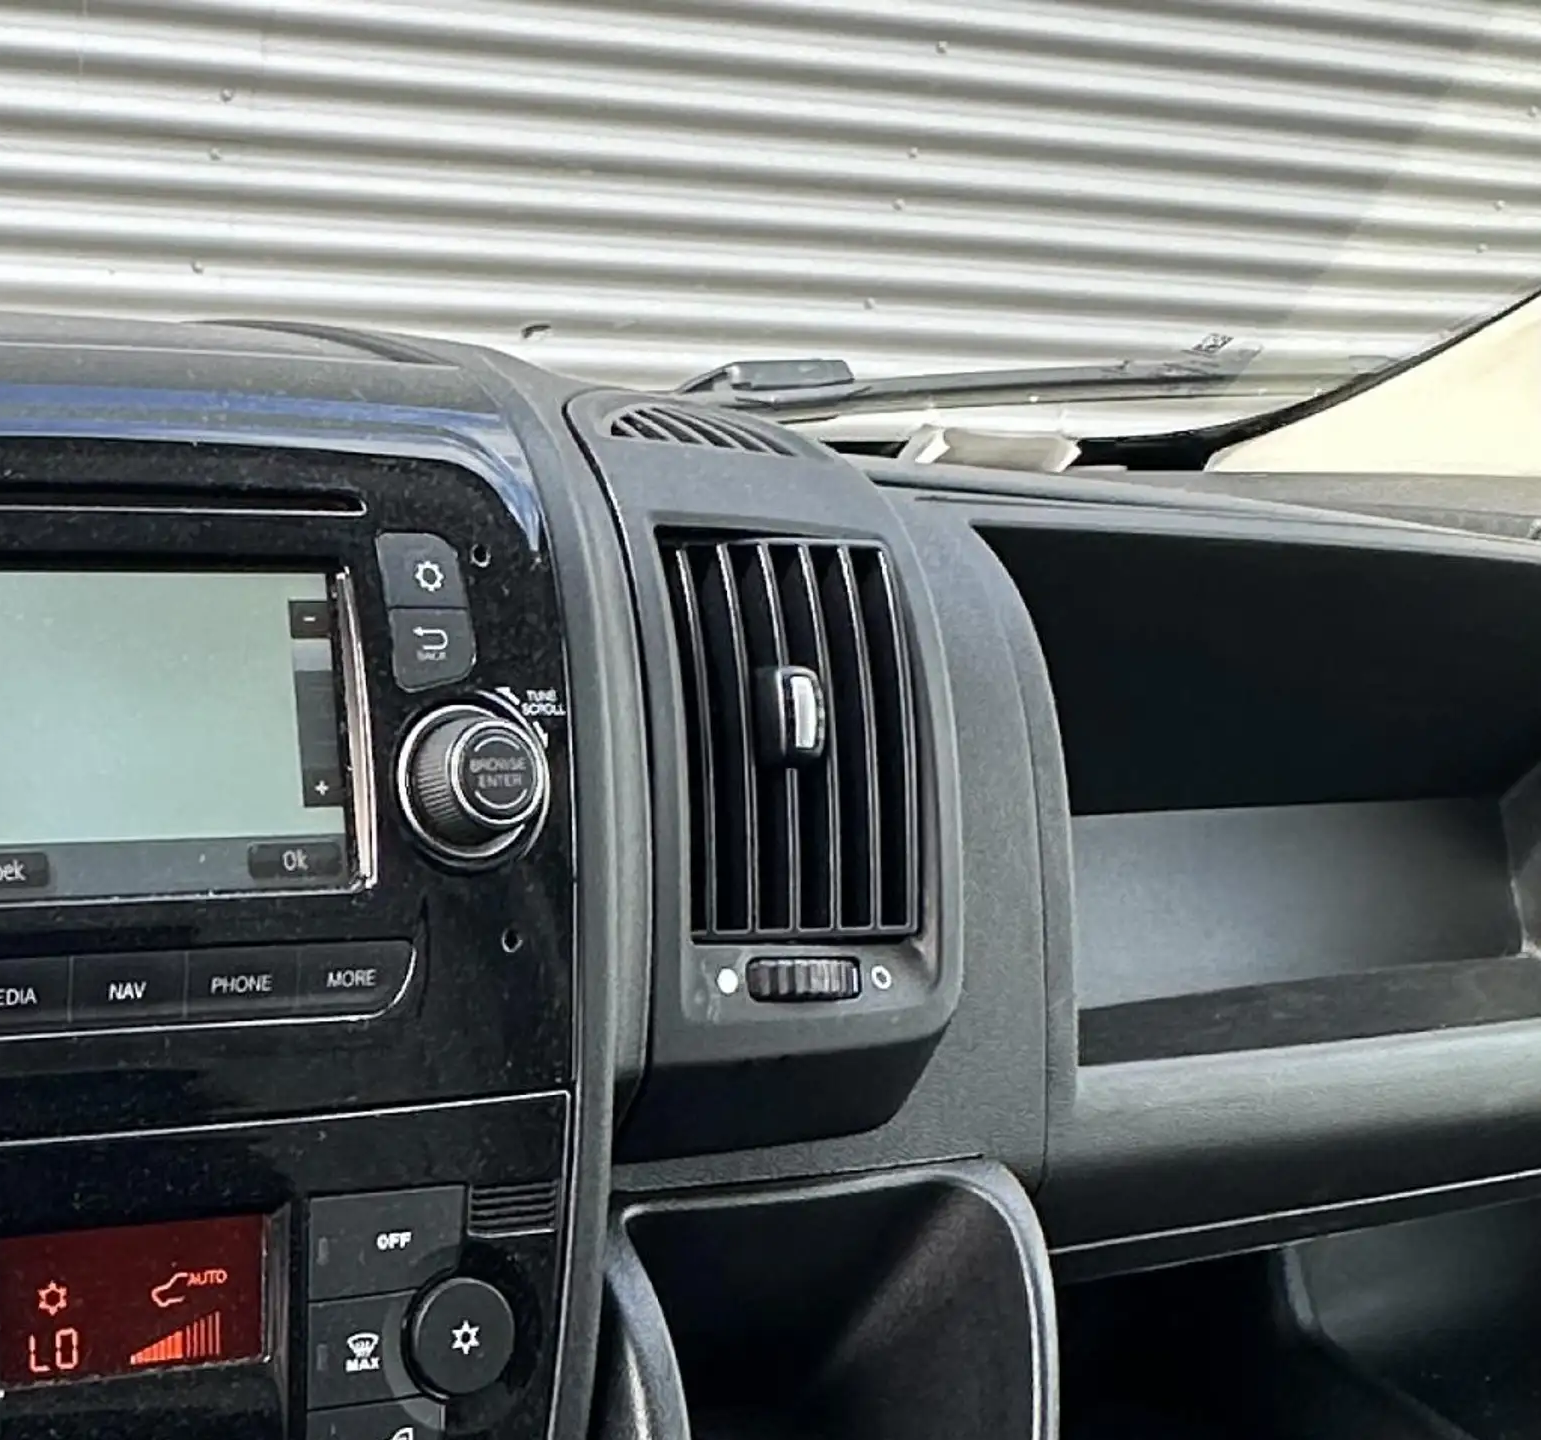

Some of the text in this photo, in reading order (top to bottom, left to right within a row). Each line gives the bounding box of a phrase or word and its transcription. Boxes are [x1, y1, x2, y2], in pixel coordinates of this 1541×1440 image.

[521, 703, 566, 716] SCROLL
[469, 757, 527, 772] BROWSE
[477, 774, 522, 788] ENTER
[283, 849, 309, 871] Ok
[210, 973, 273, 993] PHONE
[327, 968, 377, 989] MORE
[108, 981, 146, 1000] NAV
[376, 1231, 412, 1250] OFF
[187, 1268, 228, 1287] AUTO
[345, 1356, 380, 1373] MAX
